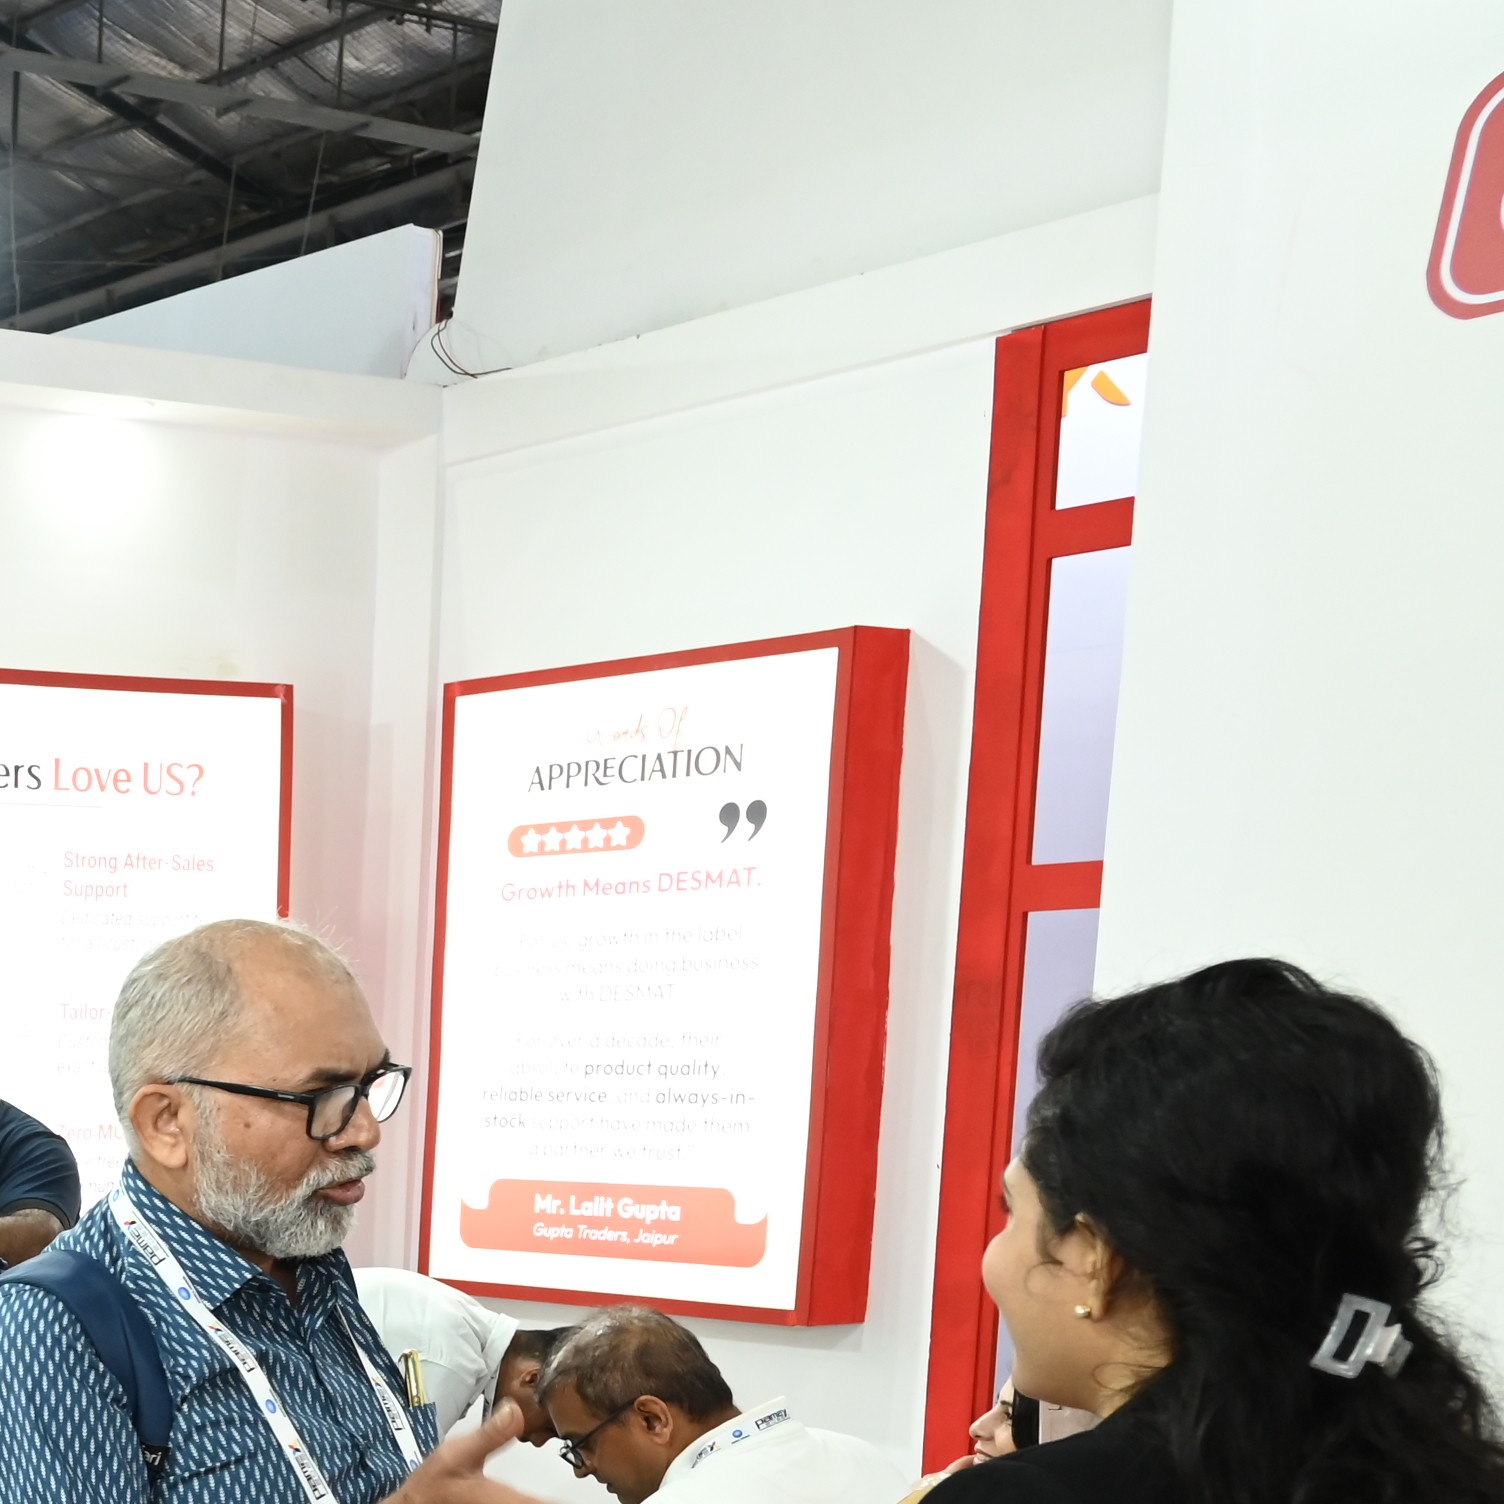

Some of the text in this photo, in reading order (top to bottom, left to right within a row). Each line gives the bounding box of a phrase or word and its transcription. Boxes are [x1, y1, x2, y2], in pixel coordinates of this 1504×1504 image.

[53, 757, 132, 794] Love
[143, 762, 205, 797] US?
[528, 743, 744, 792] APPRECIATION
[63, 850, 215, 873] Strong After-Sales
[63, 879, 128, 901] Support
[501, 866, 762, 901] Growth Means DESMAT.
[584, 1059, 652, 1079] product
[482, 1086, 755, 1108] reliable always-in-
[484, 1113, 526, 1129] stock
[535, 1193, 681, 1225] Mr. Lalit Gupta
[533, 1222, 679, 1248] Gupta Traders, Jaipur
